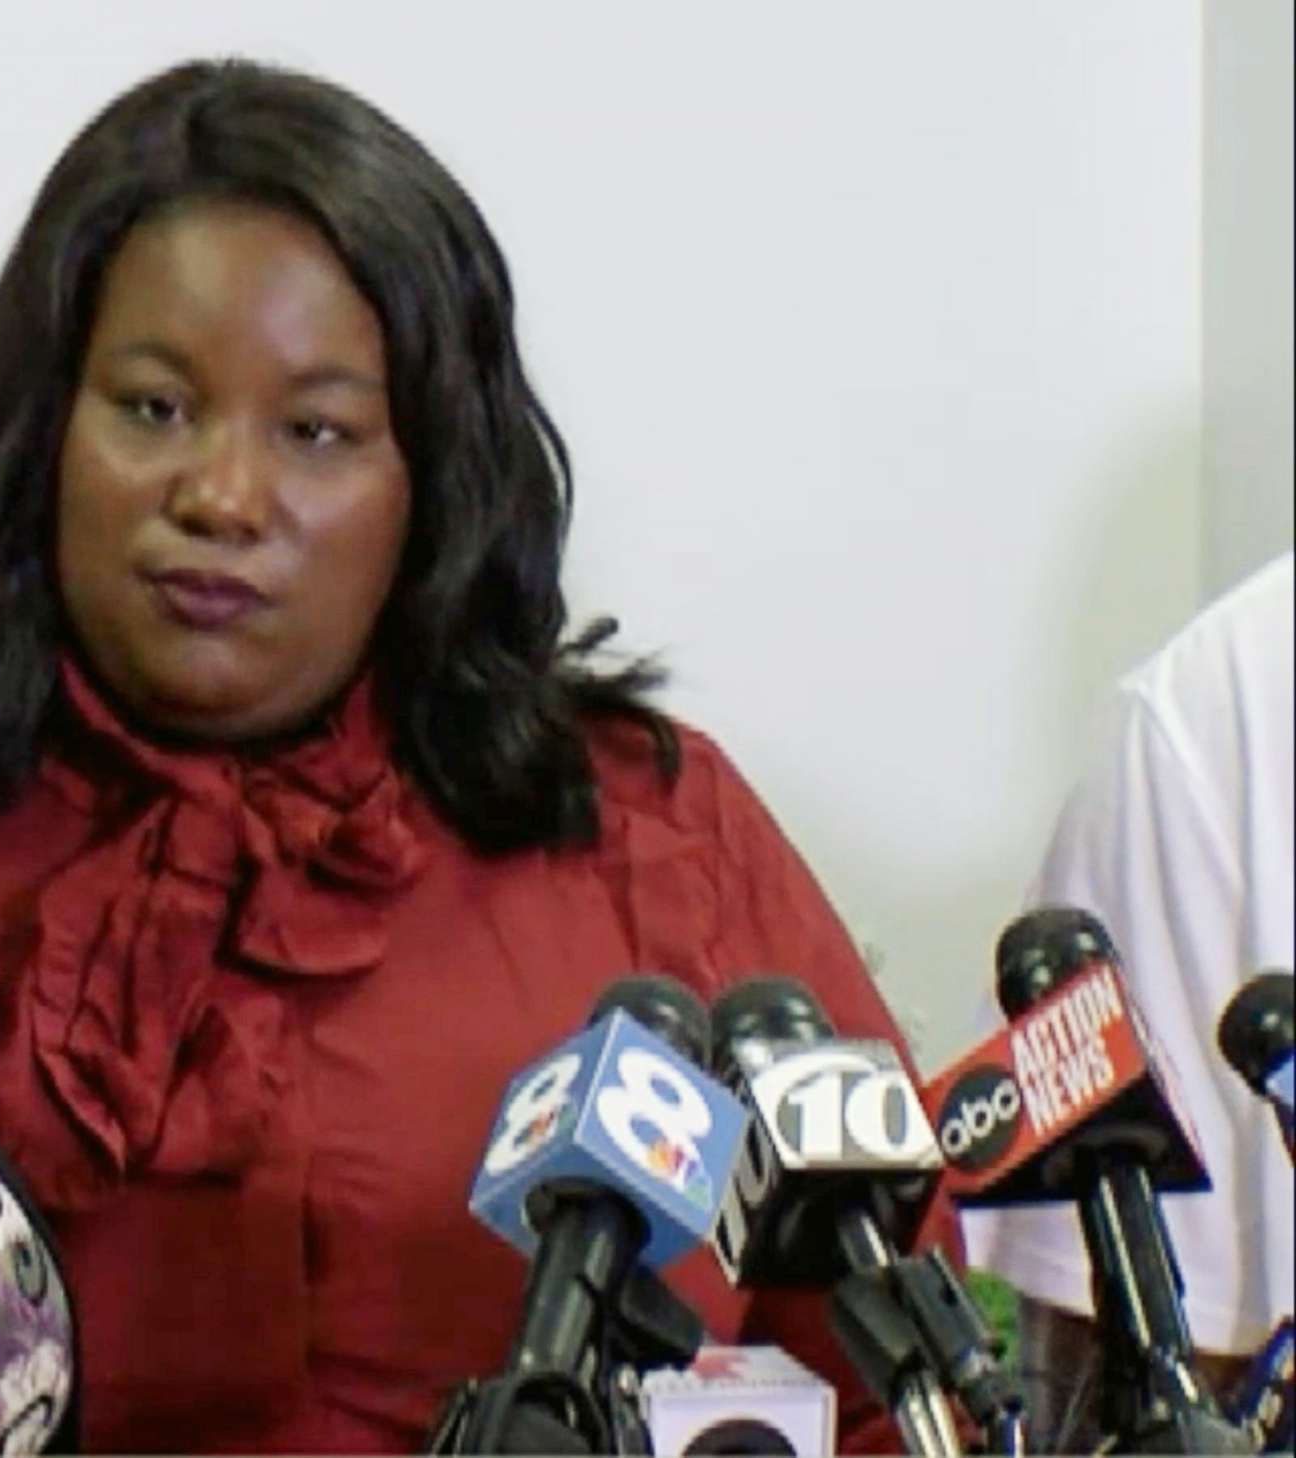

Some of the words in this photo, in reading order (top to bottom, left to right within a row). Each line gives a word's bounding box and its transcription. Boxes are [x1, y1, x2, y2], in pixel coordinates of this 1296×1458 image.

[1011, 963, 1123, 1088] ACTION
[483, 1053, 582, 1175] 8
[597, 1046, 712, 1196] 8
[787, 1070, 937, 1162] 10
[941, 1078, 1022, 1156] abc
[1019, 1035, 1115, 1136] NEWS
